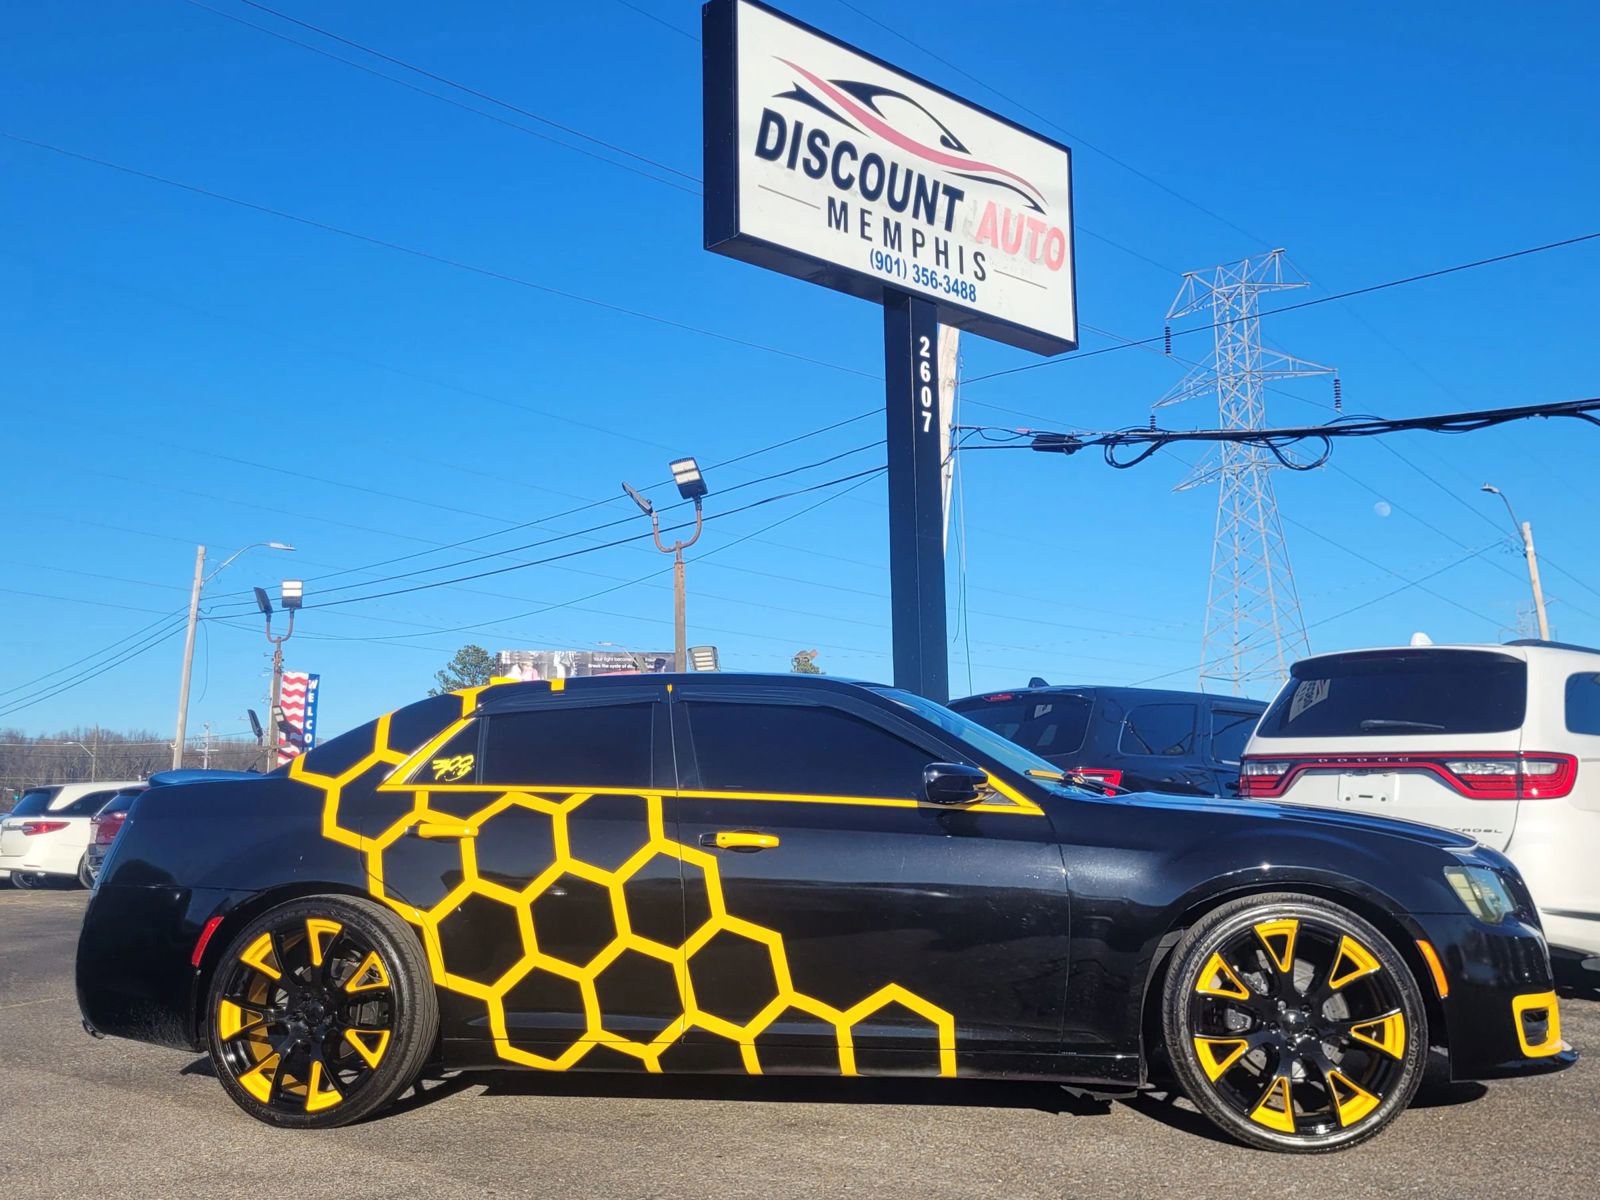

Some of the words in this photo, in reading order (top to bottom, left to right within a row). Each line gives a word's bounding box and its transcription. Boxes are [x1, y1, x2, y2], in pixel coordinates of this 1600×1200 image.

[755, 107, 964, 233] DISCOUNT
[975, 200, 1065, 272] AUTO
[827, 196, 987, 281] MEMPHIS
[869, 248, 907, 281] (901)
[912, 264, 977, 302] 356-3488
[918, 336, 932, 433] 2607
[304, 679, 318, 751] WELCO
